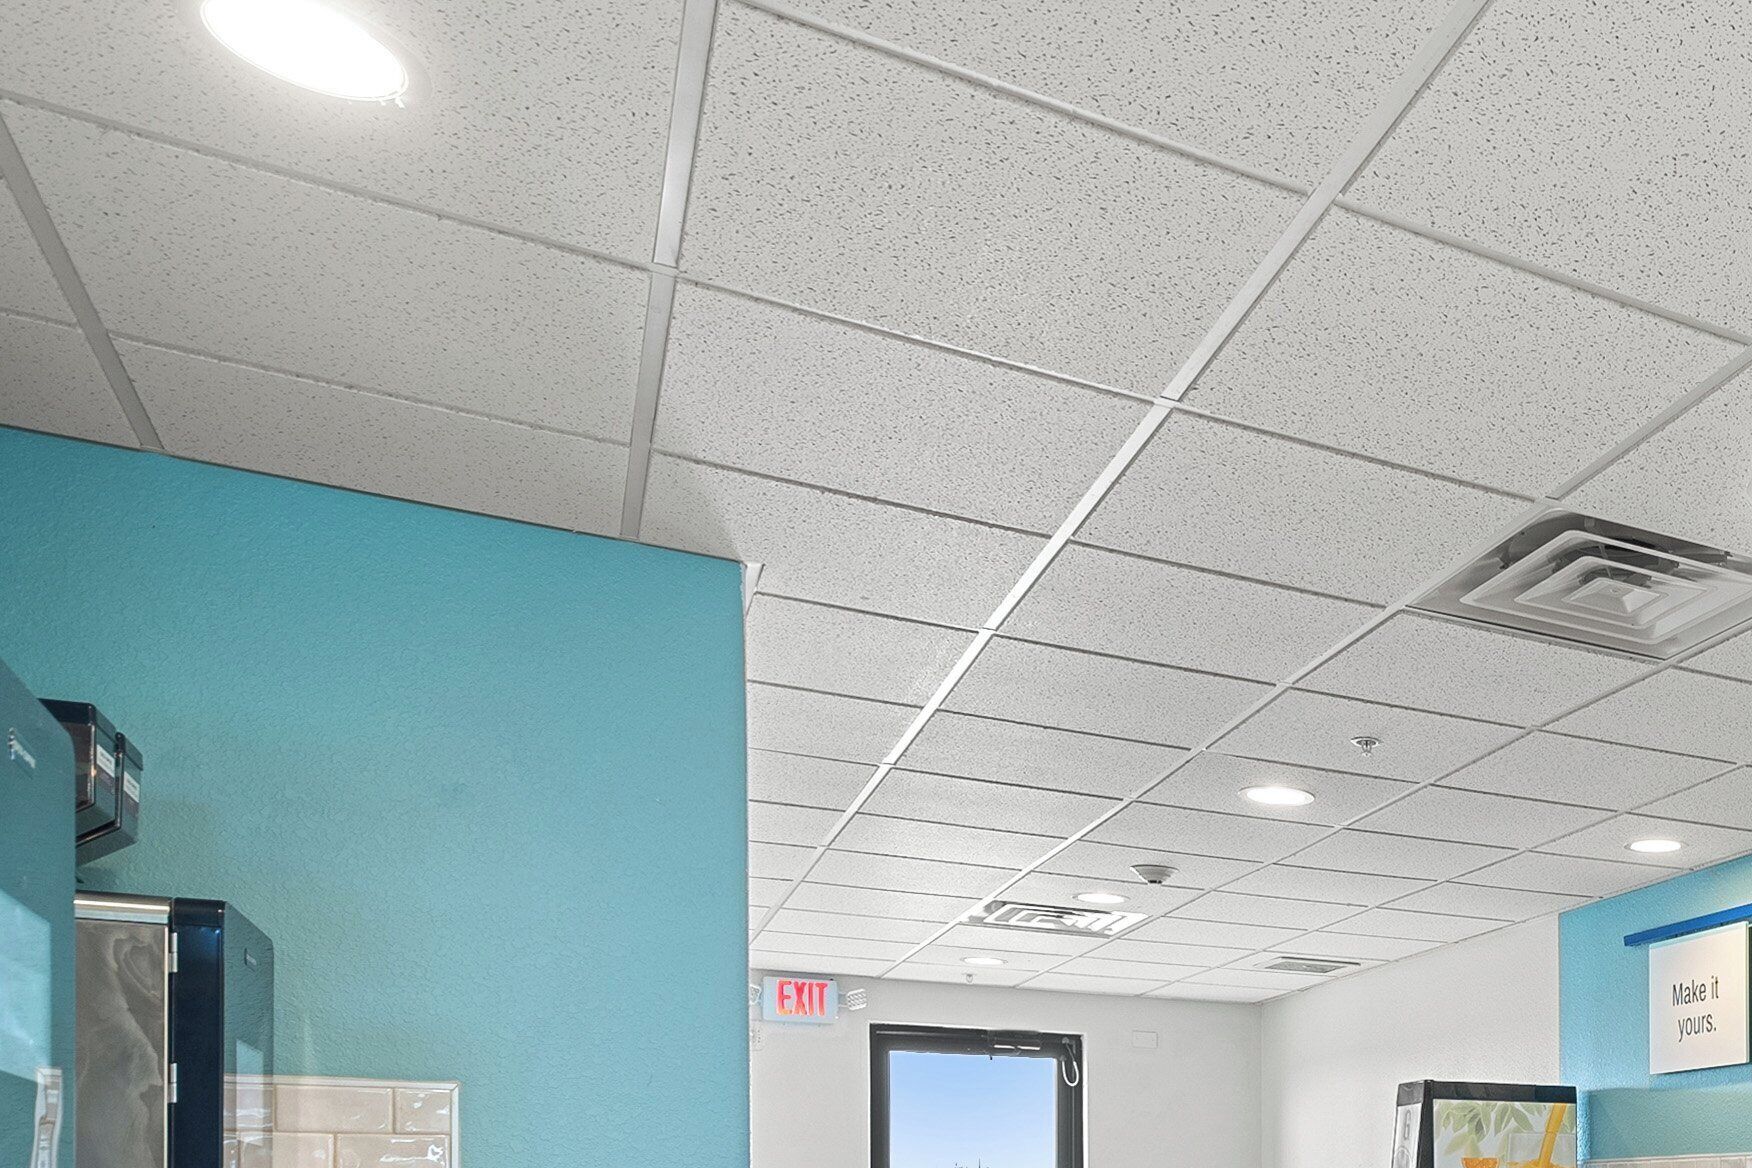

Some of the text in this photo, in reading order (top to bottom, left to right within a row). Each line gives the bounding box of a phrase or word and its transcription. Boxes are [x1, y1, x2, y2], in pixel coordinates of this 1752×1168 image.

[776, 979, 828, 1017] EXIT
[1672, 975, 1719, 1007] Make it
[1677, 1013, 1718, 1043] yours.
